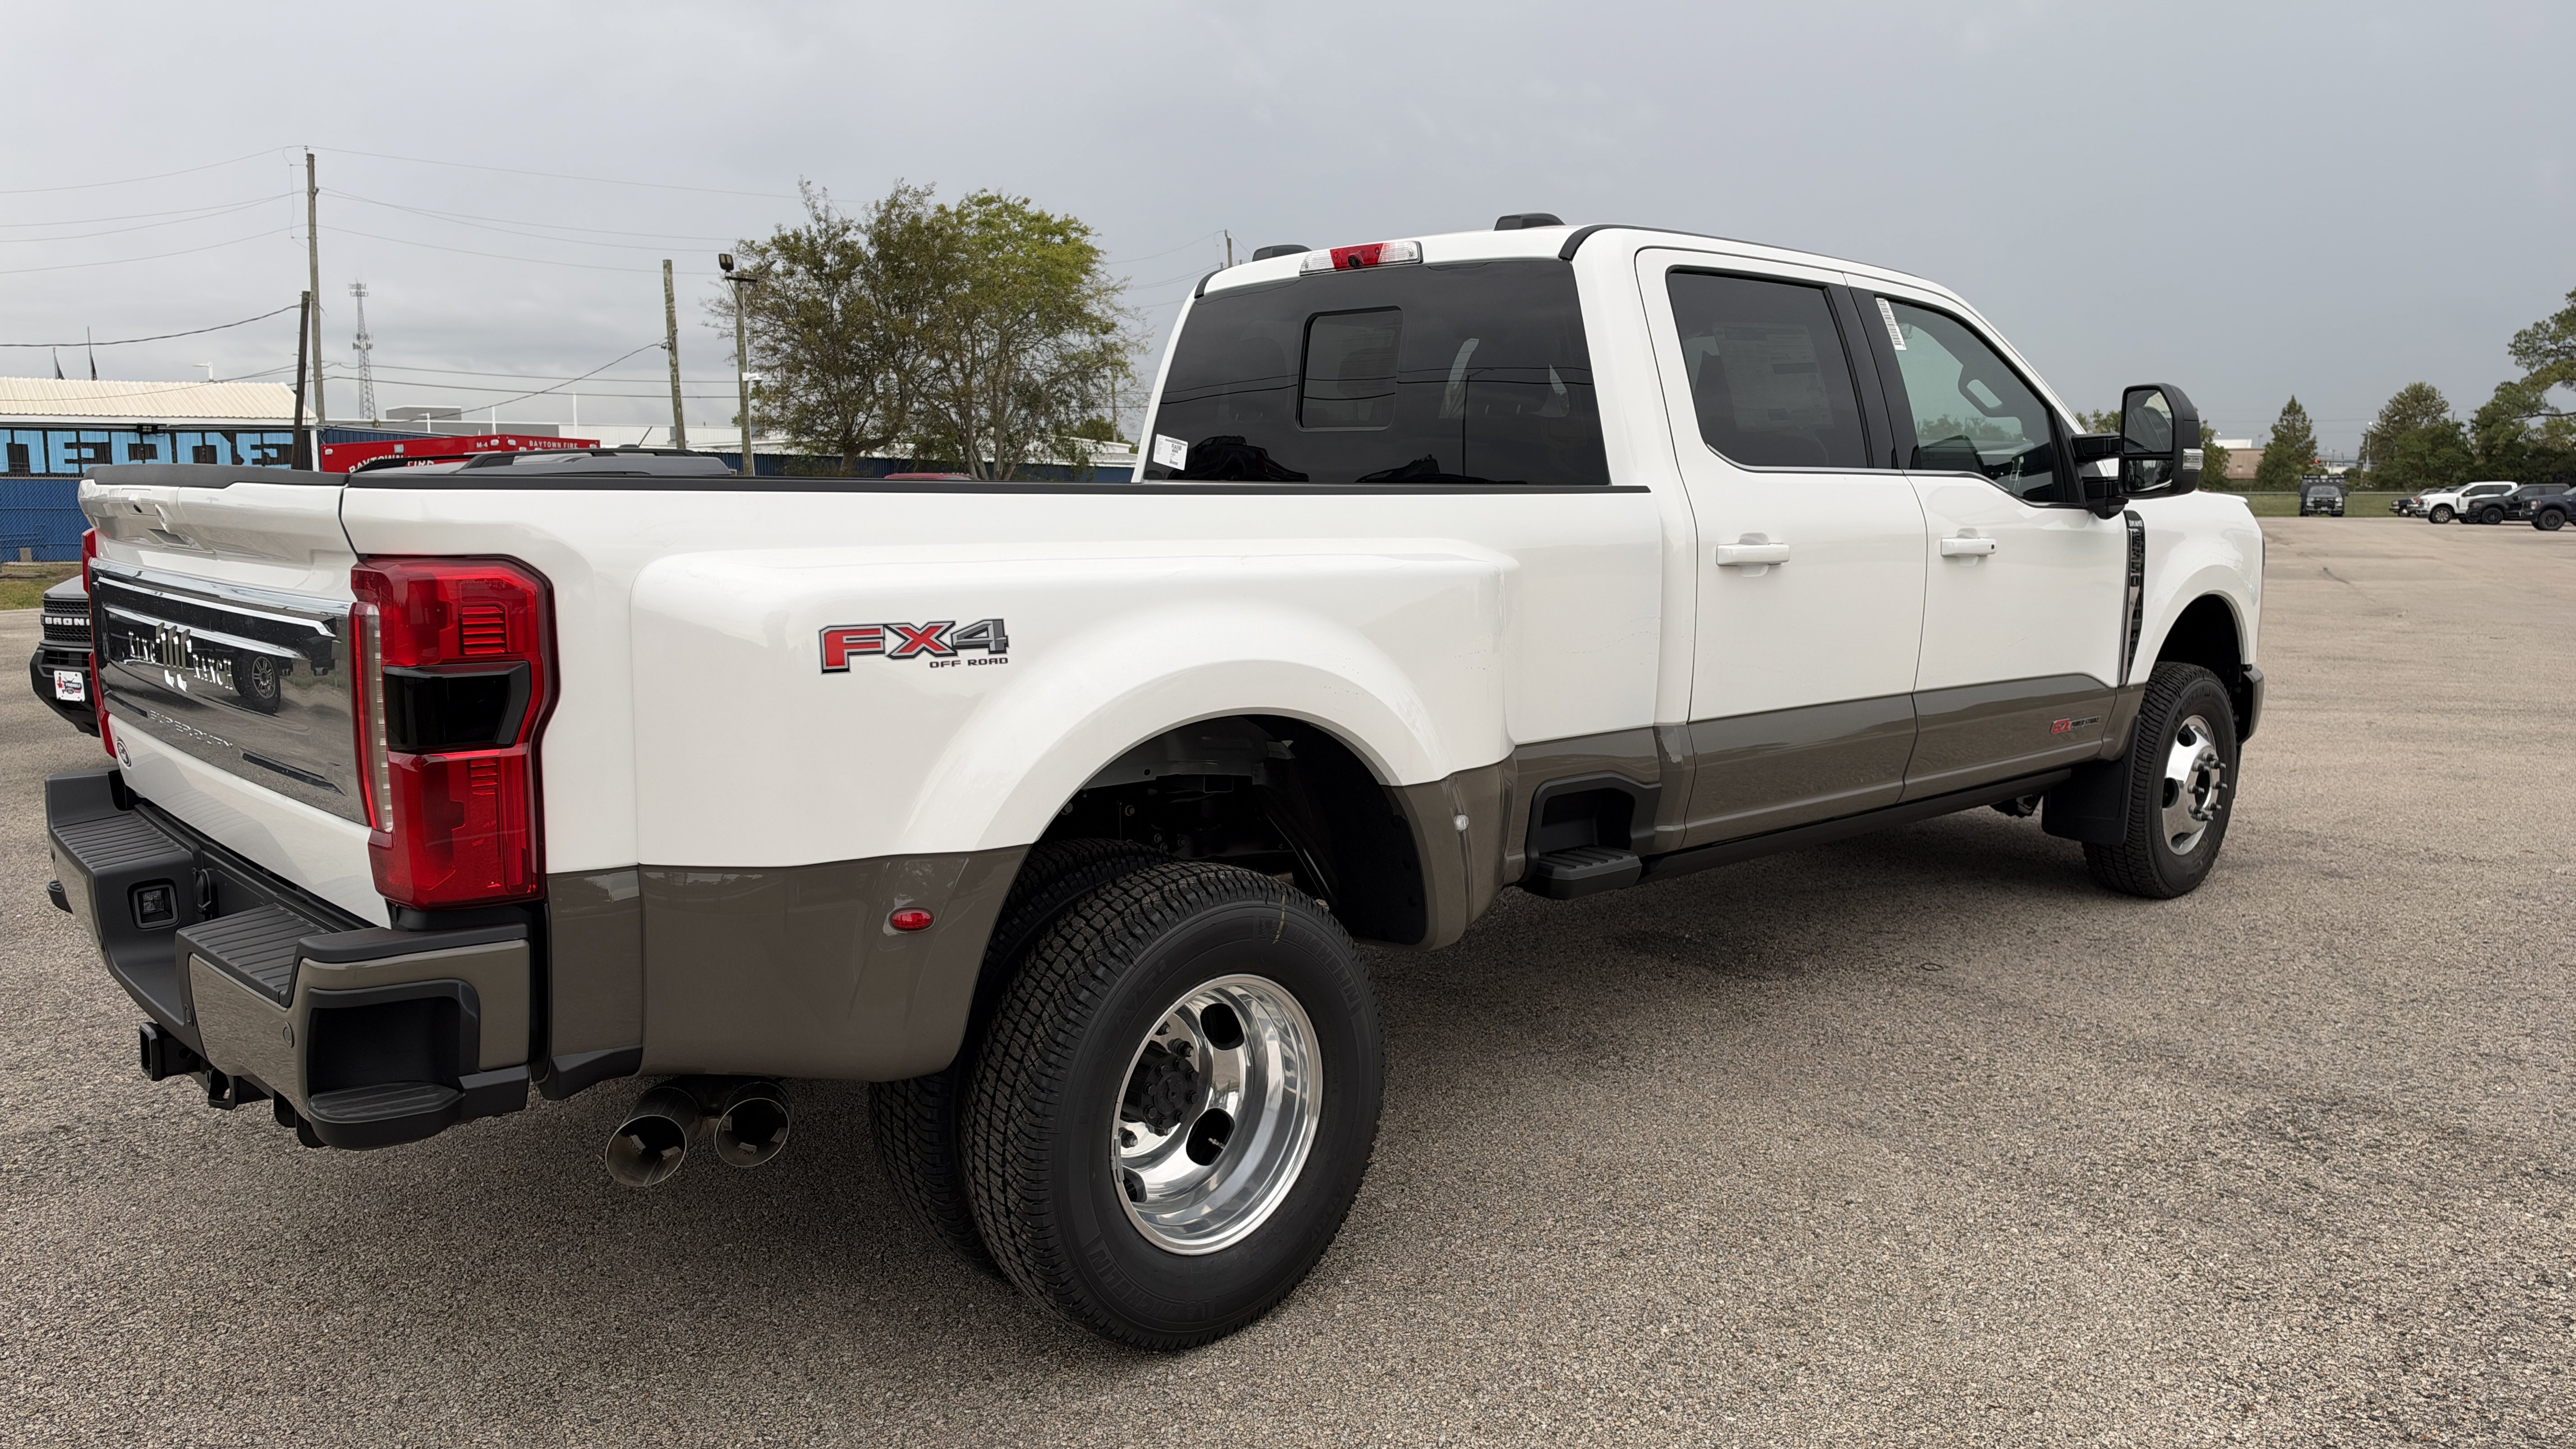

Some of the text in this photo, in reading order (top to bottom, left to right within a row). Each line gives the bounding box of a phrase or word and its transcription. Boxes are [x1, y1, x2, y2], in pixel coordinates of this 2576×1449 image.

[529, 440, 561, 448] BAYTOWN
[818, 617, 1010, 675] FX4
[929, 657, 1009, 668] OFF ROAD
[1283, 923, 1362, 1004] MICHELIN
